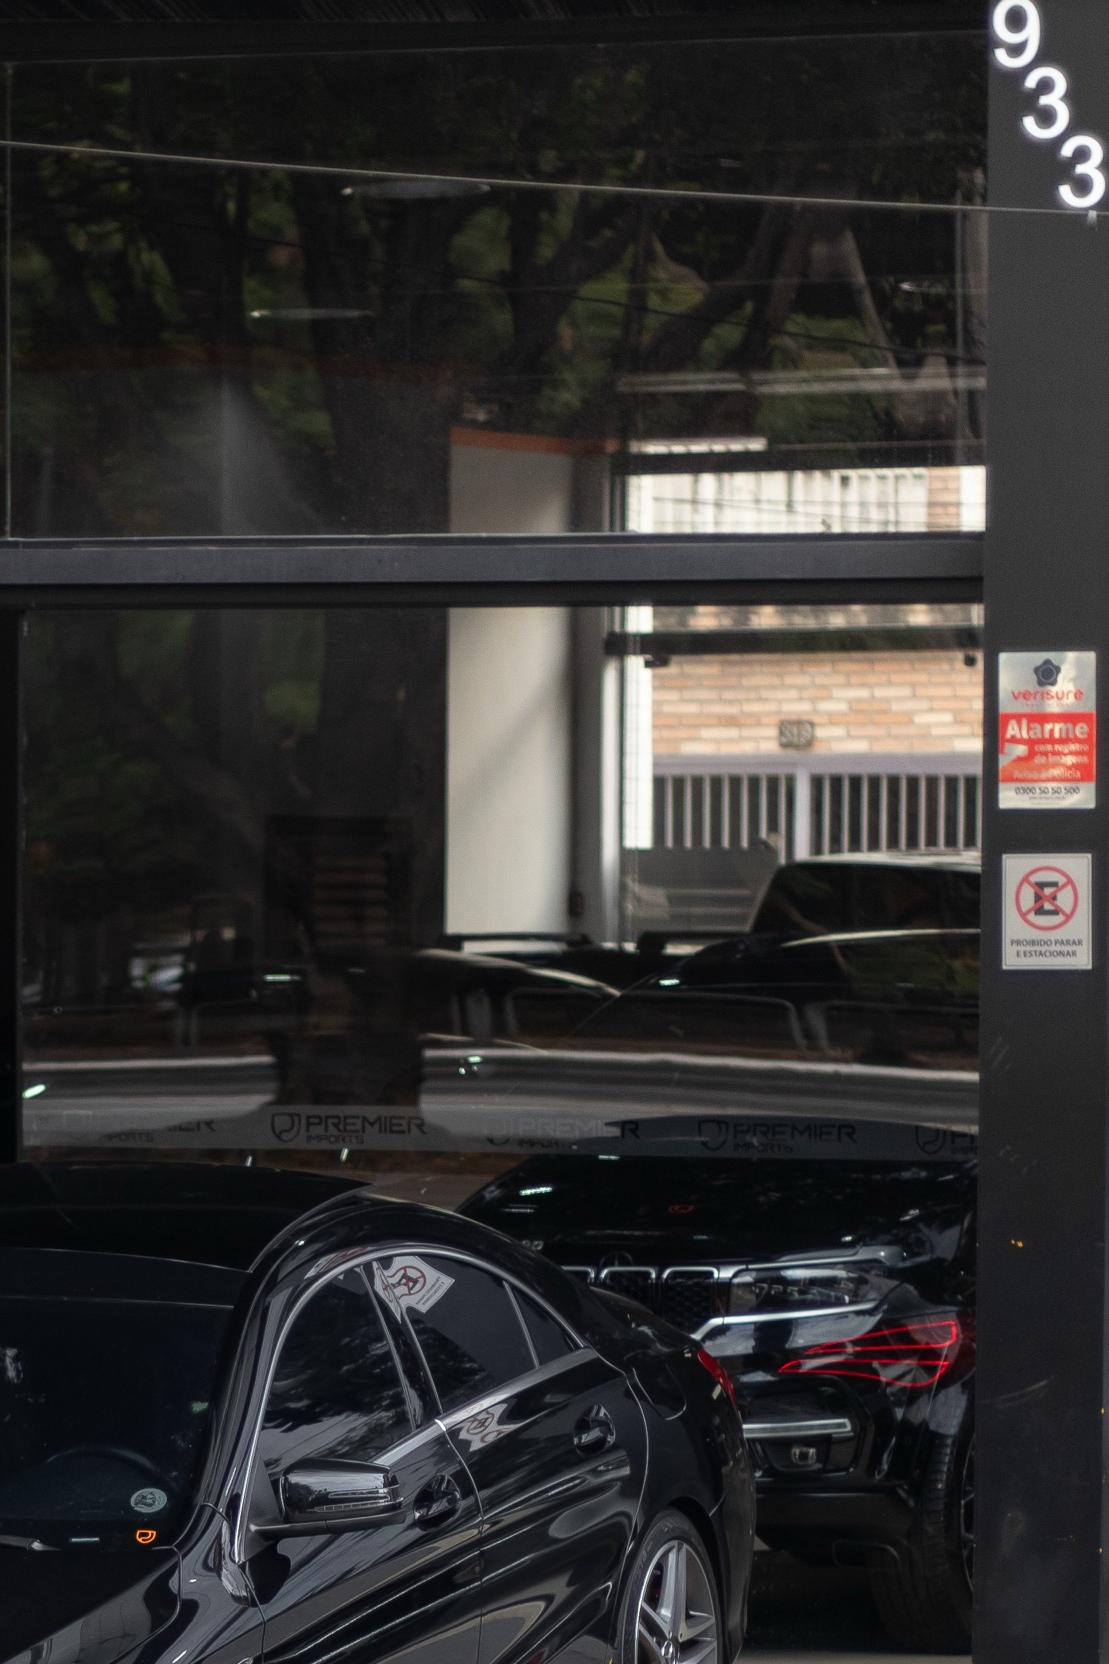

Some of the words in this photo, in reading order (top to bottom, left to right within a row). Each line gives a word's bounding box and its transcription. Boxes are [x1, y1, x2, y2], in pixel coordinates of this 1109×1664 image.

[1011, 690, 1084, 701] verisure
[1005, 718, 1089, 739] Alarme
[305, 1115, 427, 1135] PREMIER
[733, 1121, 858, 1144] PREMIER
[305, 1135, 365, 1145] IMPORTS
[733, 1143, 793, 1155] IMPORTS
